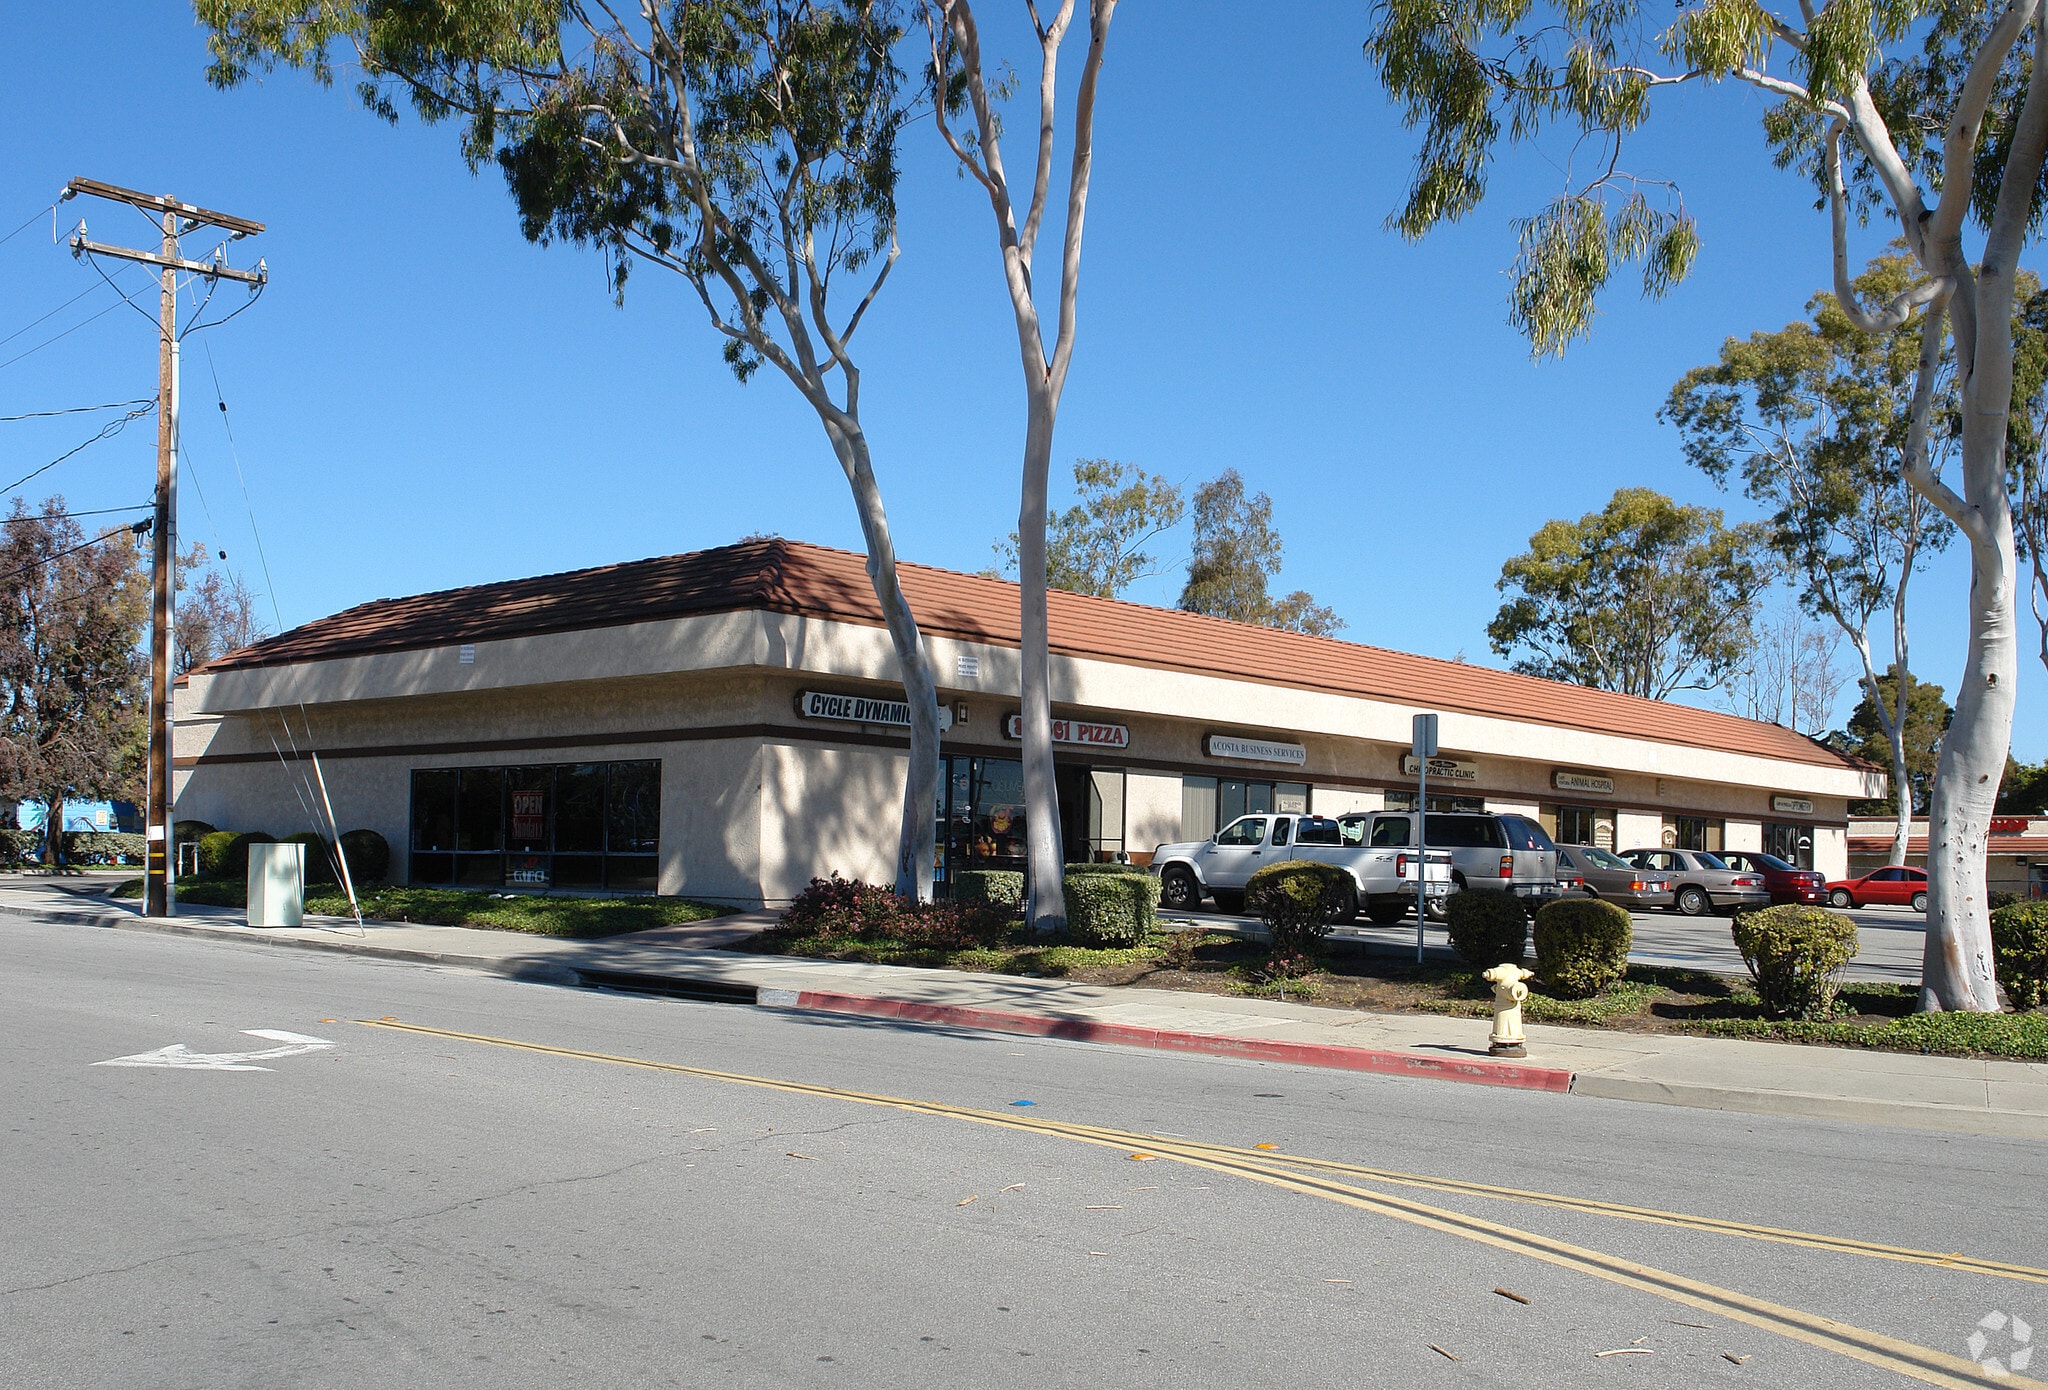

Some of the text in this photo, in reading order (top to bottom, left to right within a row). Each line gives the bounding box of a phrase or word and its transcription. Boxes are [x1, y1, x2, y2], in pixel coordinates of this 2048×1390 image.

[810, 694, 850, 717] CYCLE
[1077, 724, 1124, 744] PIZZA
[1212, 741, 1305, 759] ACOSTA BUSINESS SERVICES
[1409, 764, 1454, 776] CHIOPRACTIC
[1455, 769, 1475, 779] CLINIC
[1570, 776, 1591, 788] ANIMAL
[1591, 779, 1613, 790] HOSPITAL
[514, 795, 543, 814] OPEN
